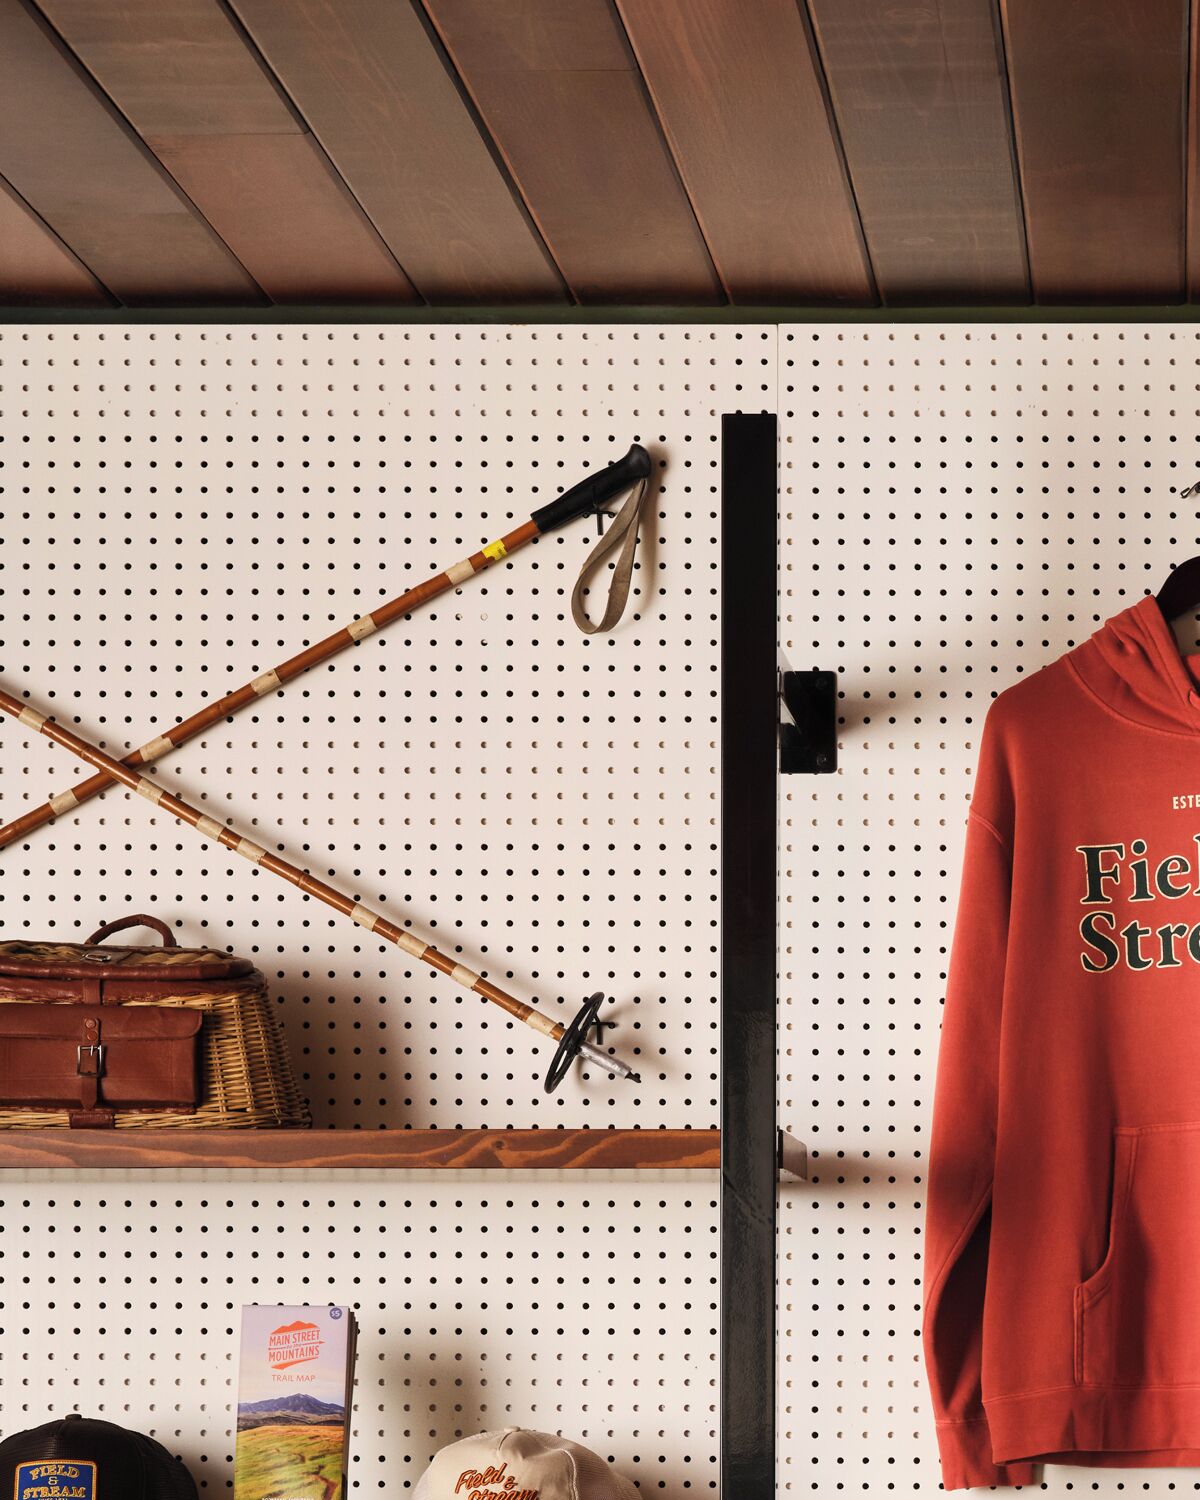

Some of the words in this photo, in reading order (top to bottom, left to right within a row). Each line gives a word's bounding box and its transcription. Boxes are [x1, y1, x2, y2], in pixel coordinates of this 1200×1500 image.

[269, 1334, 290, 1346] MAIN
[292, 1330, 320, 1344] STREET
[268, 1345, 320, 1362] MOUNTAINS
[271, 1374, 294, 1382] TRAIL
[296, 1374, 316, 1382] MAP
[29, 1464, 80, 1480] FIELD
[455, 1462, 508, 1494] Field
[504, 1475, 518, 1490] &
[23, 1486, 87, 1500] STREAM
